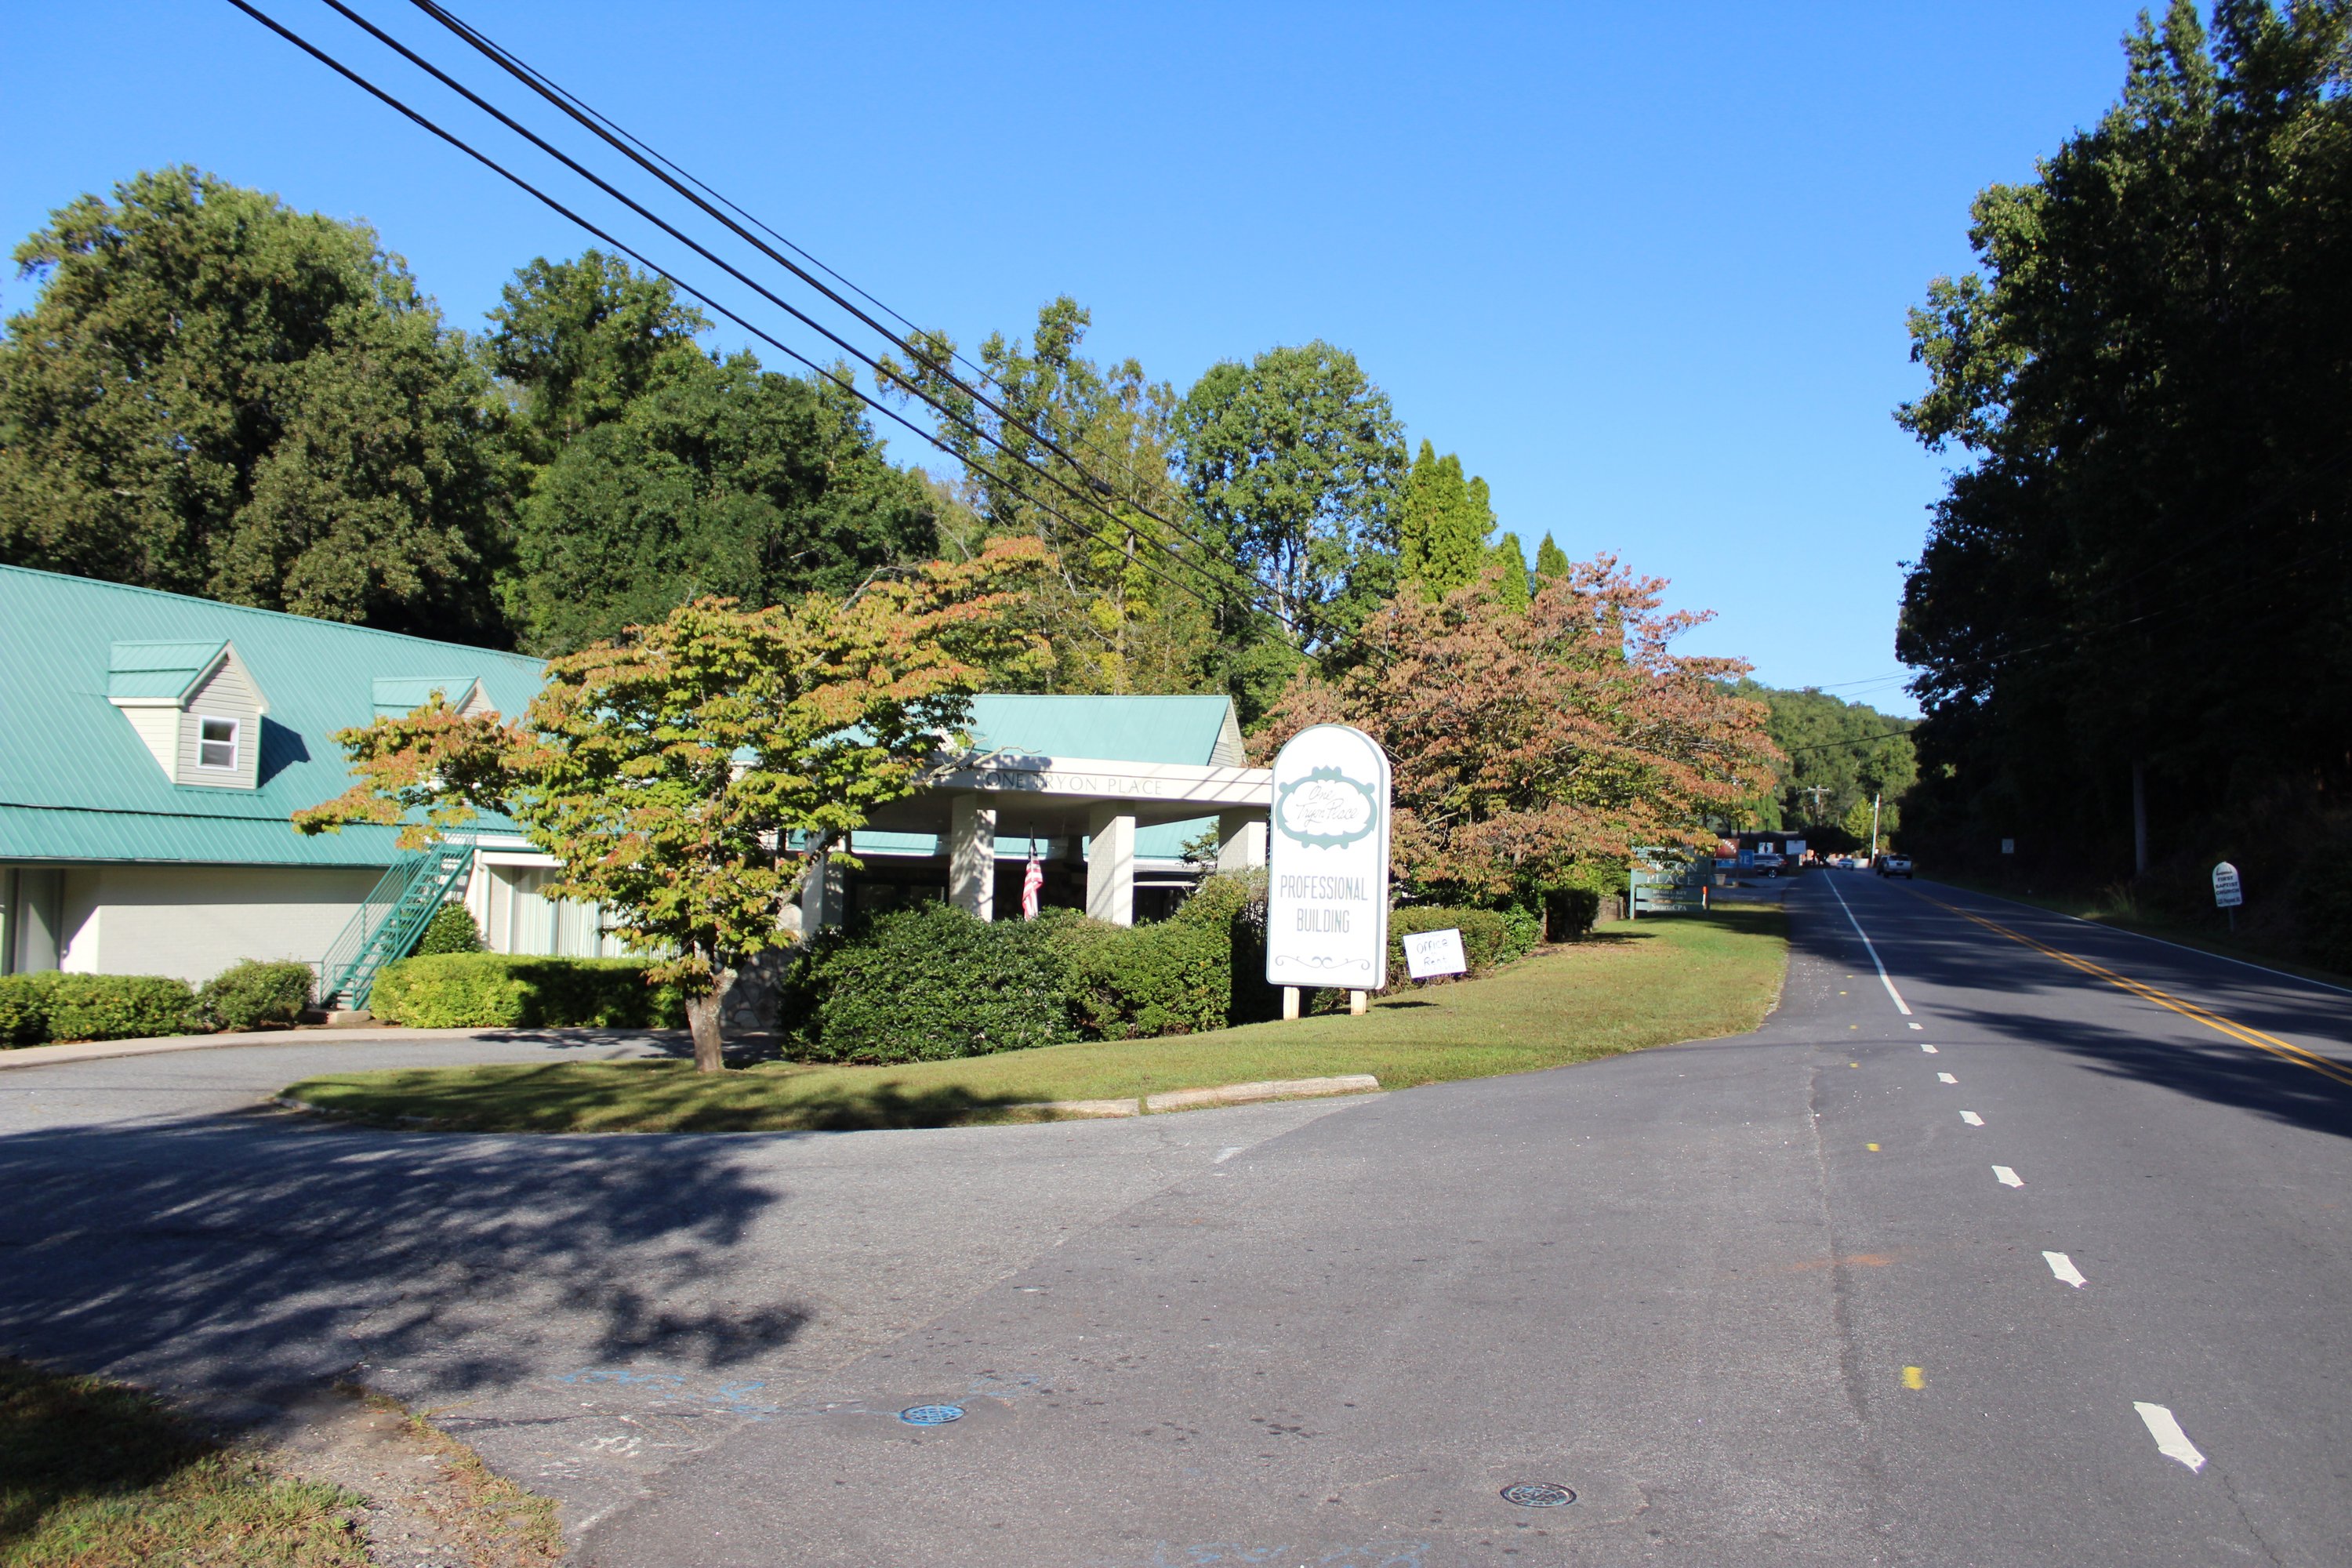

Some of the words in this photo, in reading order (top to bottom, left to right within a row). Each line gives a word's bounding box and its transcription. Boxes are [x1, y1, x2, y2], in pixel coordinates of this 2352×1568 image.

[985, 771, 1025, 789] ONE
[1033, 773, 1098, 791] TRYON
[1107, 778, 1163, 796] PLACE
[1308, 785, 1333, 800] One
[1296, 801, 1327, 827] Tryon
[1327, 797, 1359, 821] Place
[1279, 874, 1368, 902] PROFESSIONAL
[1646, 874, 1696, 885] PLACE
[1296, 908, 1350, 934] BUILDING
[1424, 955, 1447, 967] Rent
